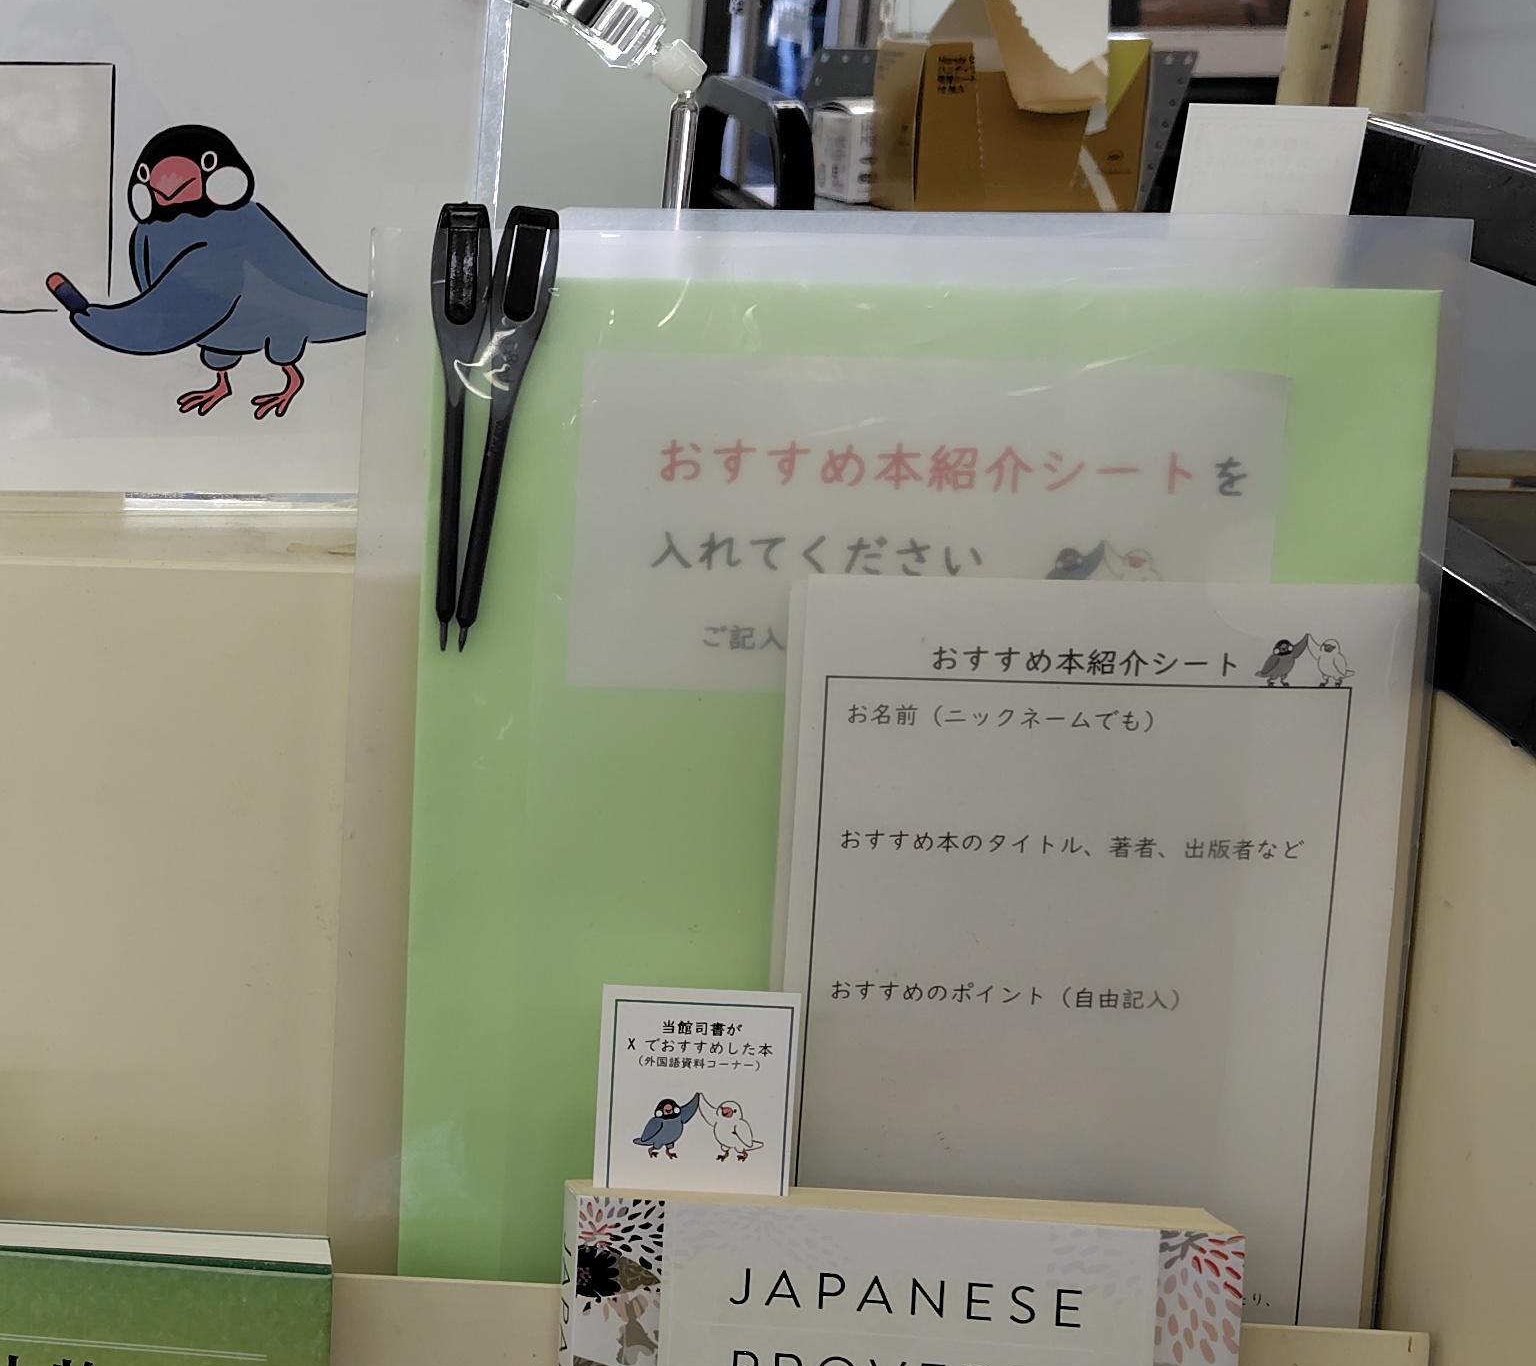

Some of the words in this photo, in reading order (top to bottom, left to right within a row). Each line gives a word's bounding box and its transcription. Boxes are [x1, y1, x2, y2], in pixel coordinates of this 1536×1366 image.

[659, 439, 1248, 497] おすすめ本紹介シートを
[650, 530, 983, 575] 入れてください
[932, 646, 1238, 679] おすすめ本紹介シート
[847, 703, 1157, 734] お名前（ニックネームでも）
[840, 829, 1305, 863] おすすめ本のタイトル、著者、出版者など
[830, 981, 1184, 1013] おすすめのポイント（自由記入）
[660, 1019, 743, 1037] 当館司書が
[627, 1037, 635, 1050] X
[644, 1038, 774, 1057] でおすすめした本
[729, 1268, 1083, 1329] JAPANESE
